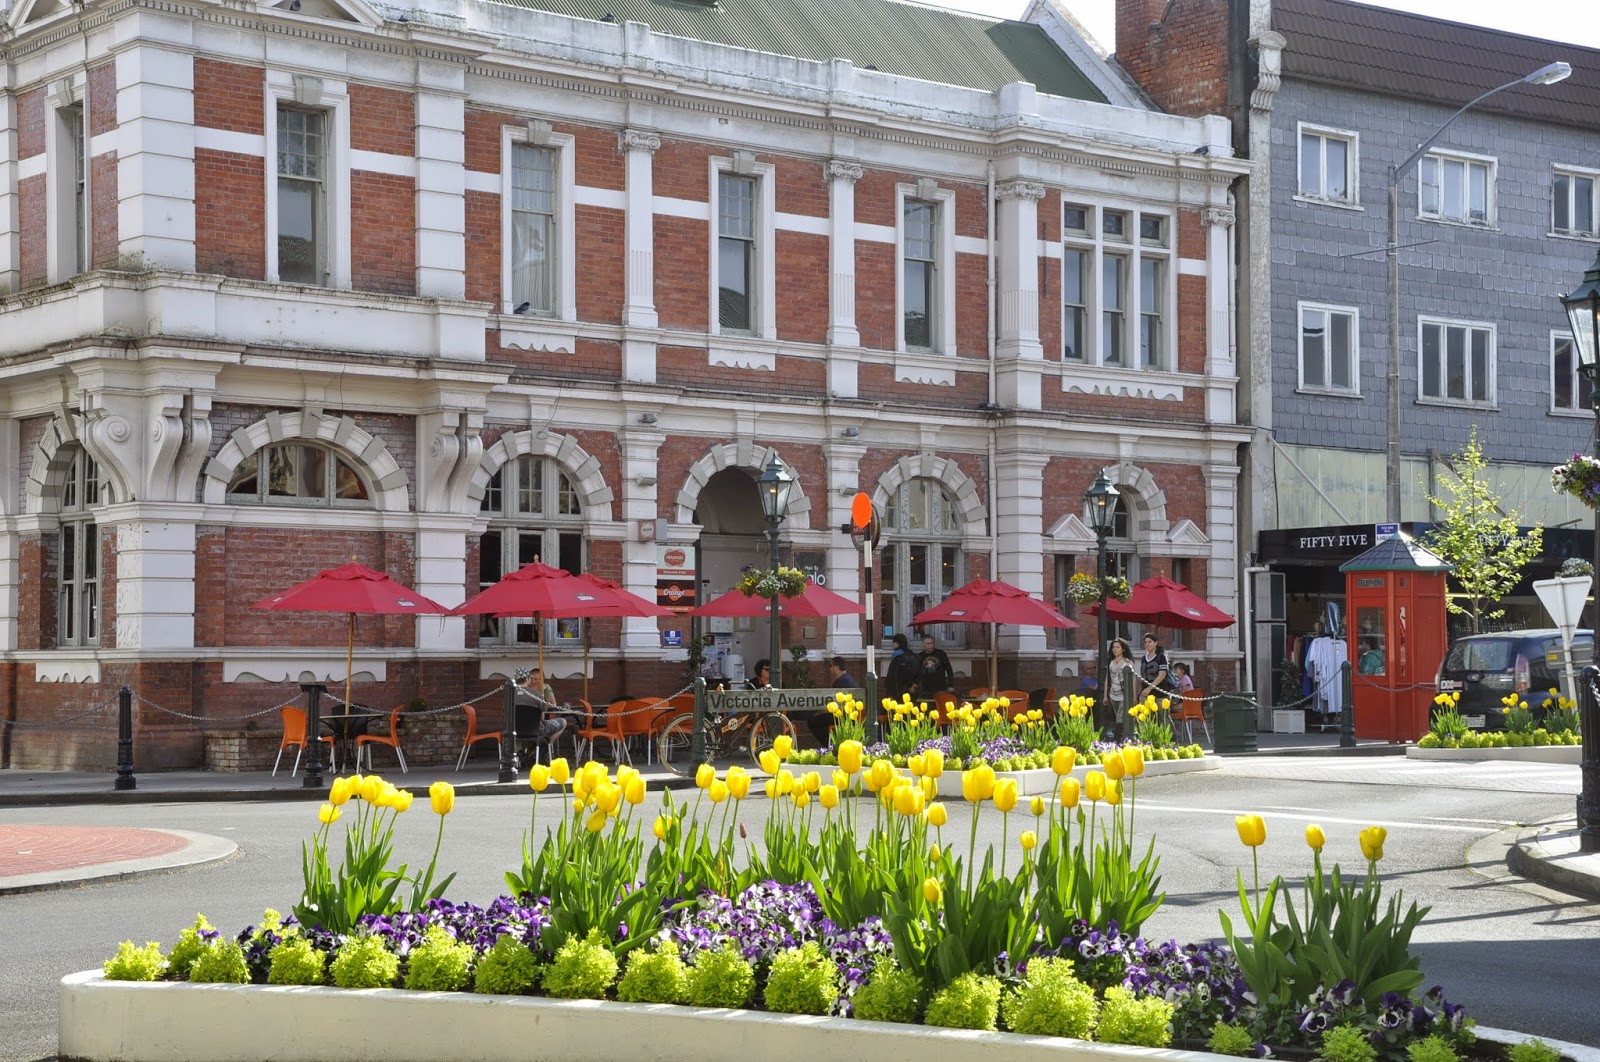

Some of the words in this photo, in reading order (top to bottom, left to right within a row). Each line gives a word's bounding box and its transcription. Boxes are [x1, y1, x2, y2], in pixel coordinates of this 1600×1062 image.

[1300, 536, 1336, 548] FIFTY
[1338, 534, 1368, 546] FIVE
[1358, 578, 1384, 588] TELEPHONE
[664, 588, 684, 598] Orange
[710, 694, 771, 709] Victoria
[776, 692, 834, 708] Avenue
